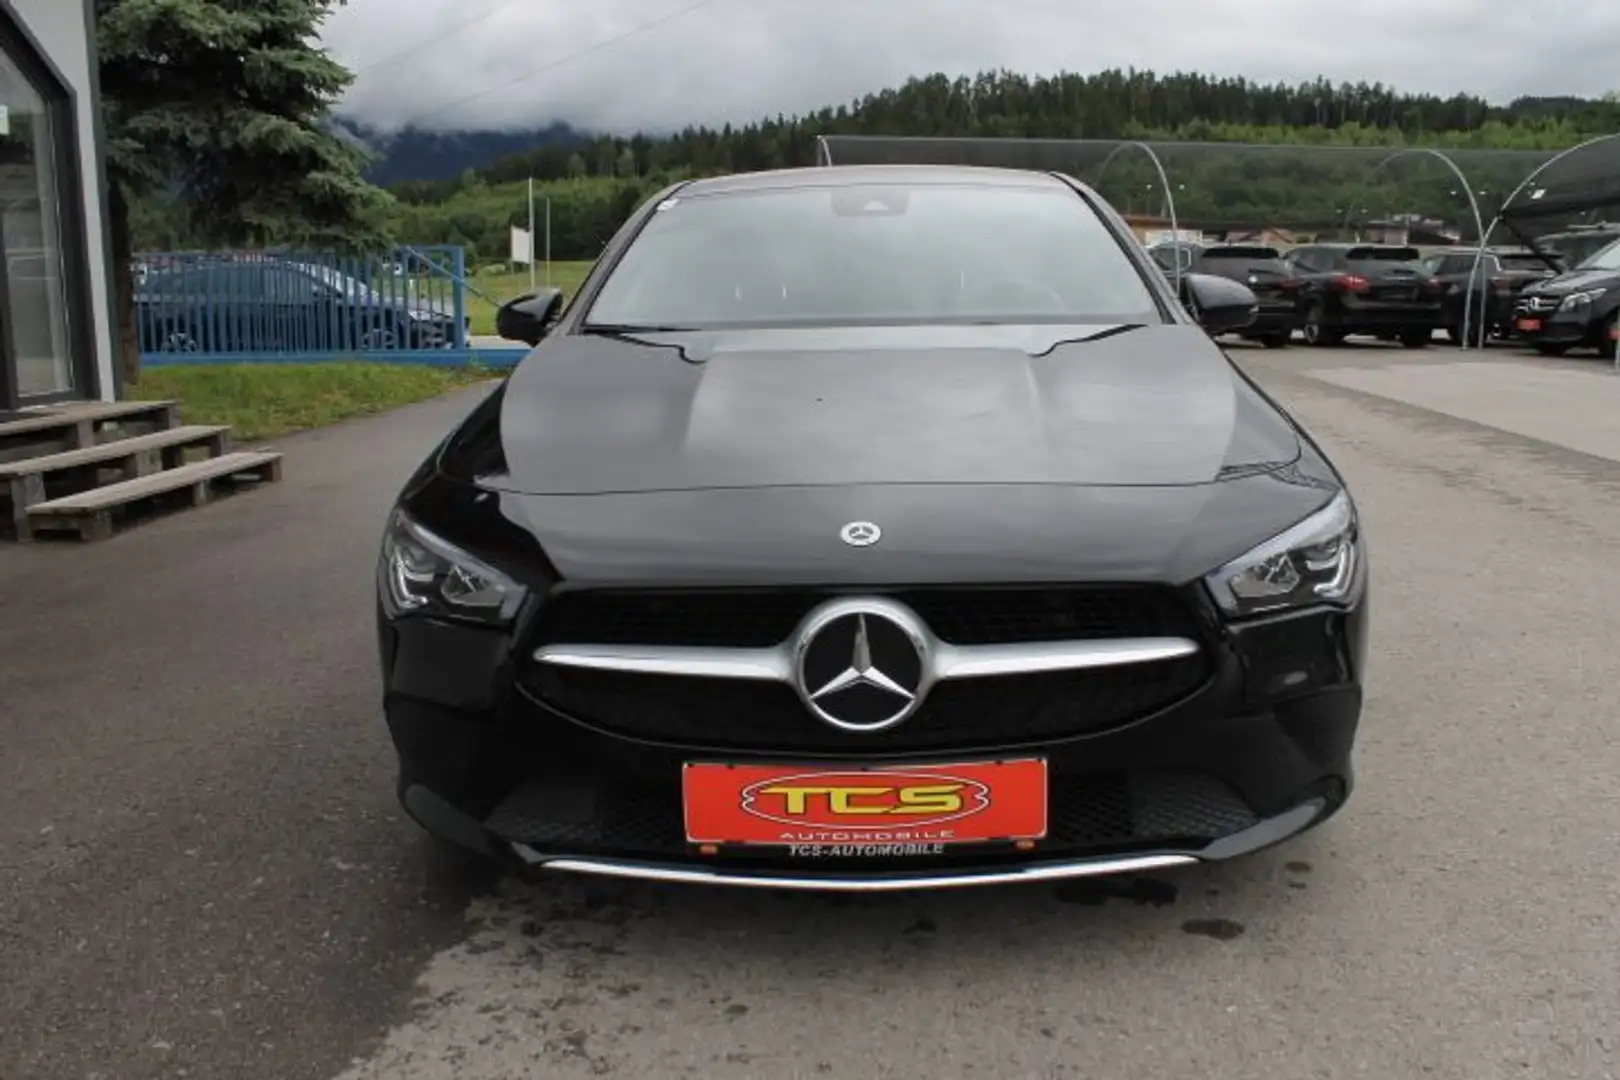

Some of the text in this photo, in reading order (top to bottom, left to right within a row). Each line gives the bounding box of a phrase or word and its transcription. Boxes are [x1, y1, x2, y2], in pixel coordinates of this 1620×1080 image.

[759, 784, 966, 815] TCS
[779, 829, 955, 840] AUTOMOBILE
[788, 843, 944, 857] TCS-AUTOMOBILE
